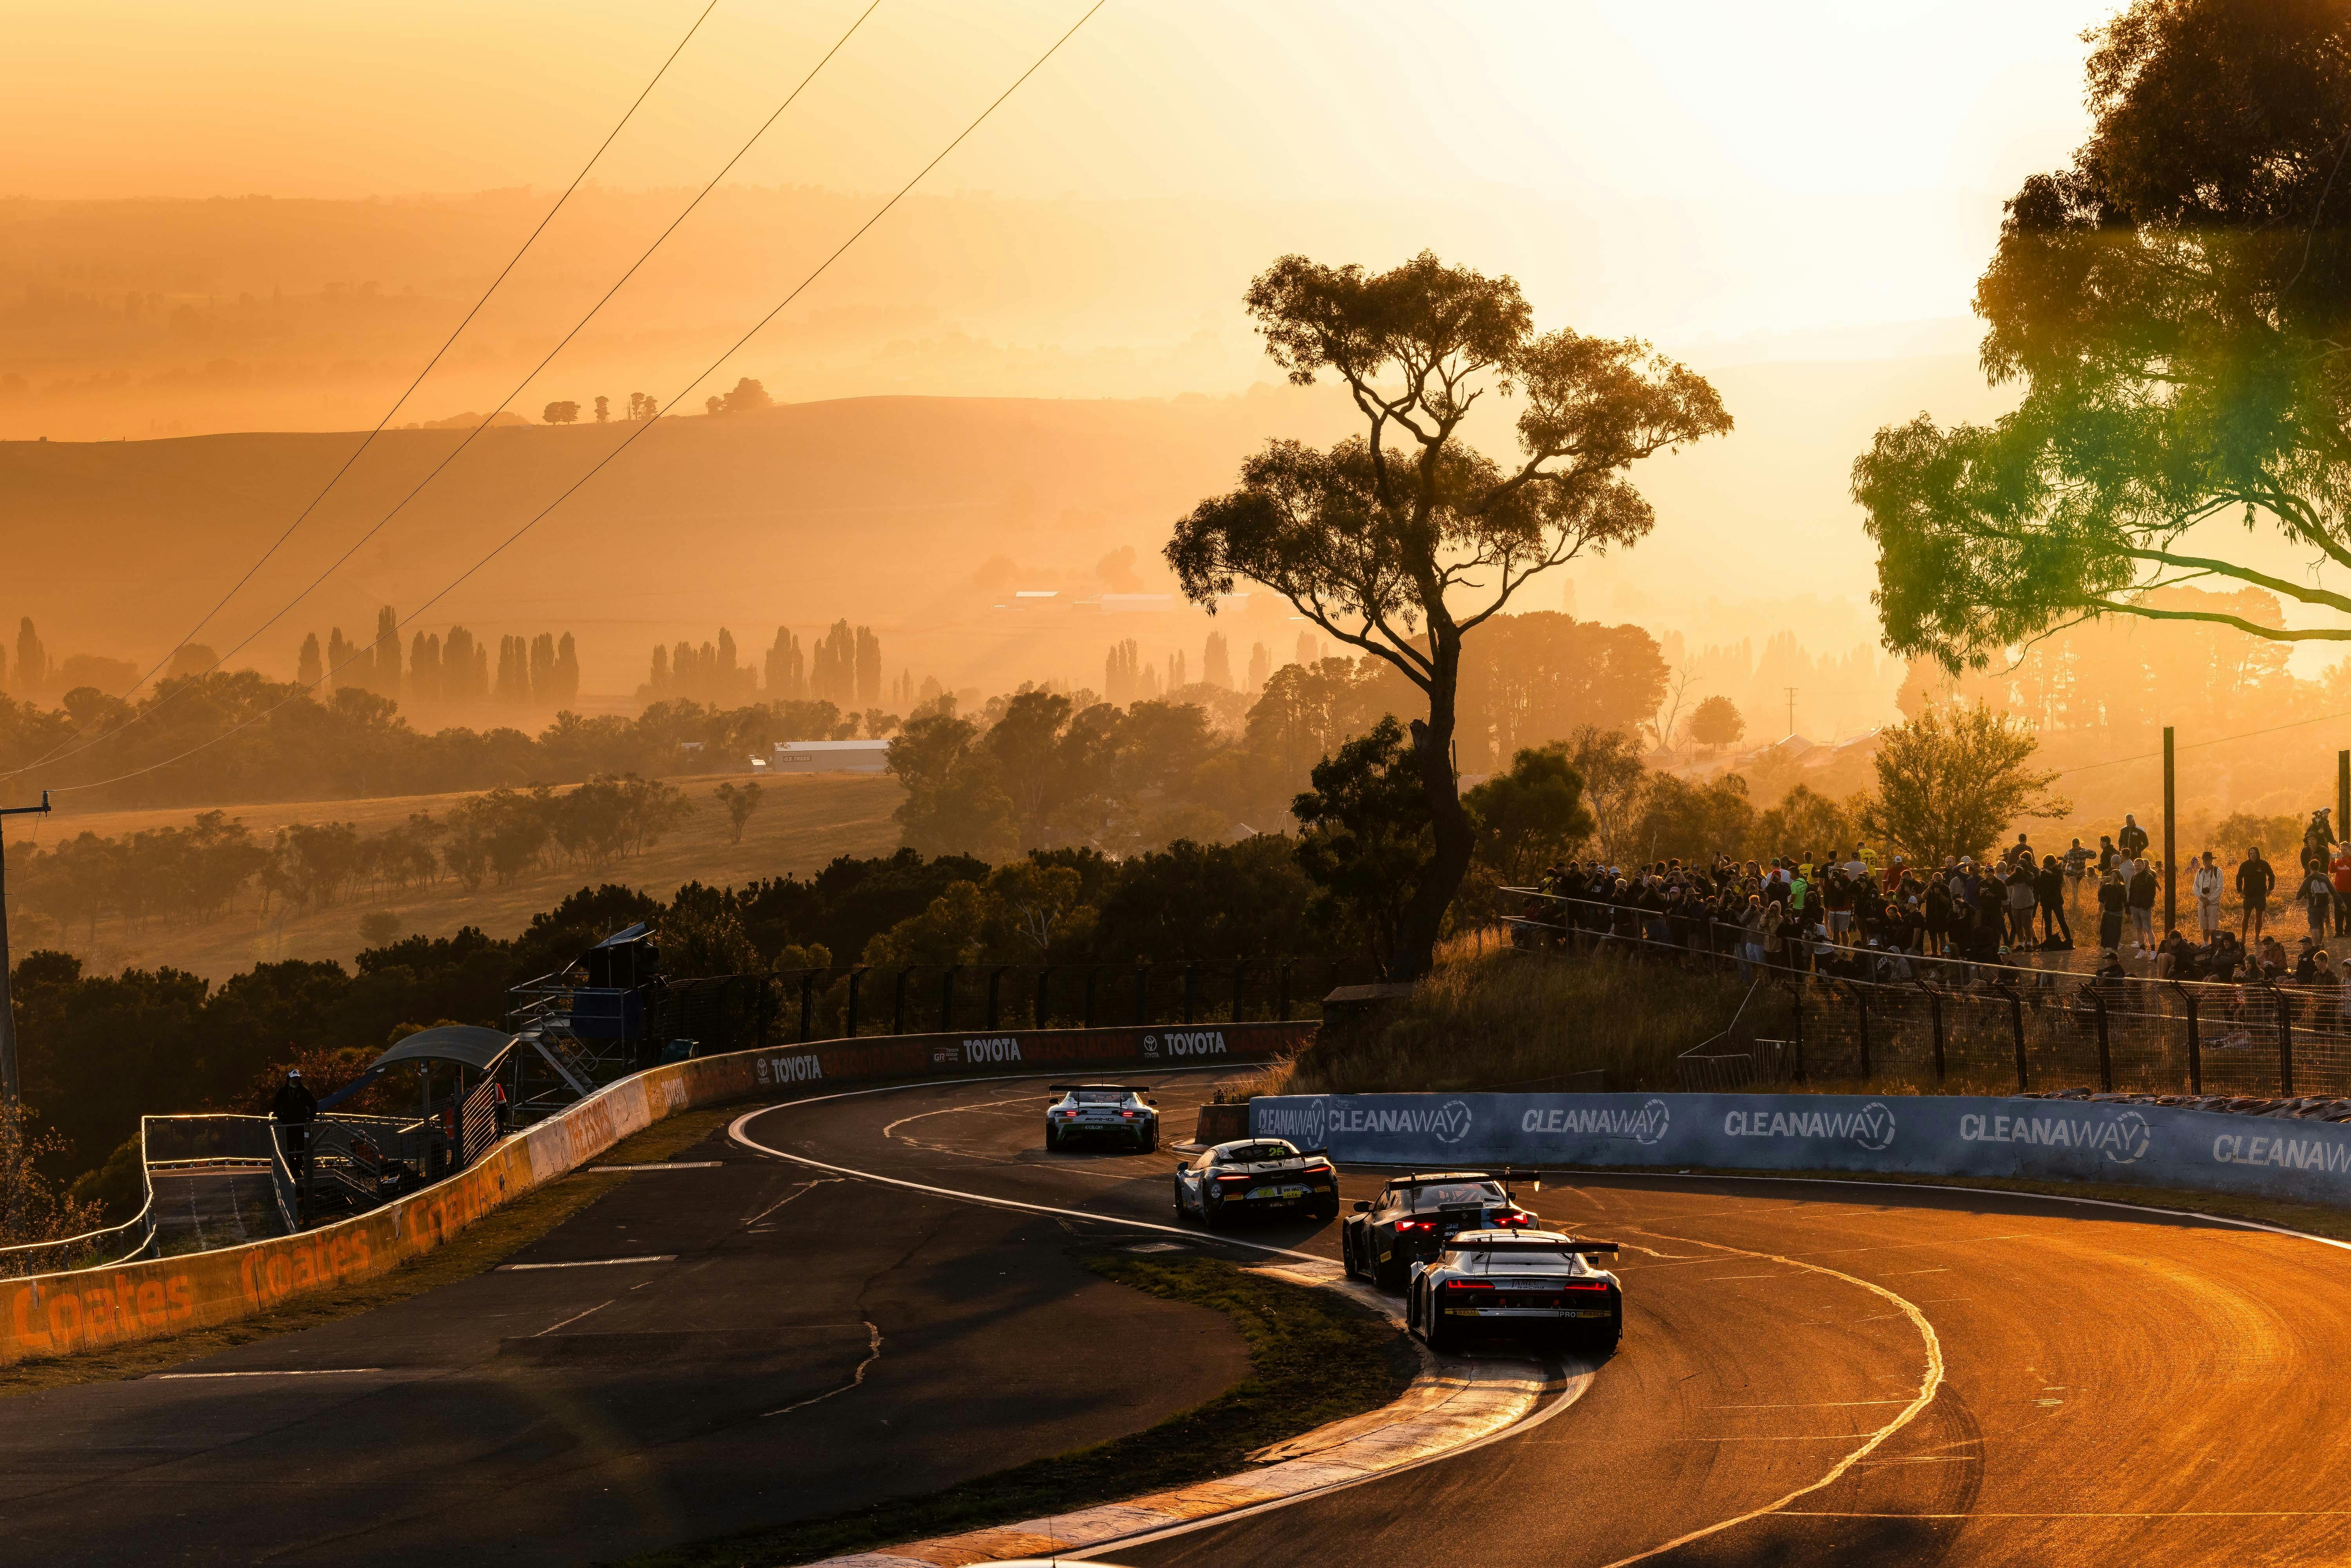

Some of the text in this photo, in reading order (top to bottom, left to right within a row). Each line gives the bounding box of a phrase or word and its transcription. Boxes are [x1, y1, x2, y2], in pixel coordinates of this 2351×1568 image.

[1862, 857, 1875, 865] 72
[964, 1038, 1021, 1063] TOYOTA
[1165, 1032, 1226, 1055] TOYOTA
[772, 1055, 822, 1083] TOYOTA
[661, 1077, 688, 1107] TOYOTA
[565, 1098, 613, 1165] THE ESSES
[1259, 1109, 1320, 1135] CLEANAWAY
[1329, 1110, 1463, 1132] CLEANAWAY
[1522, 1109, 1661, 1133] CLEANAWAY
[1724, 1111, 1884, 1138] CLEANAWAY
[1960, 1114, 2140, 1150] CLEANAWAY
[1269, 1147, 1285, 1156] 25
[14, 1274, 193, 1347] Coates
[241, 1229, 371, 1302] Coates
[1511, 1280, 1539, 1288] JAMEC
